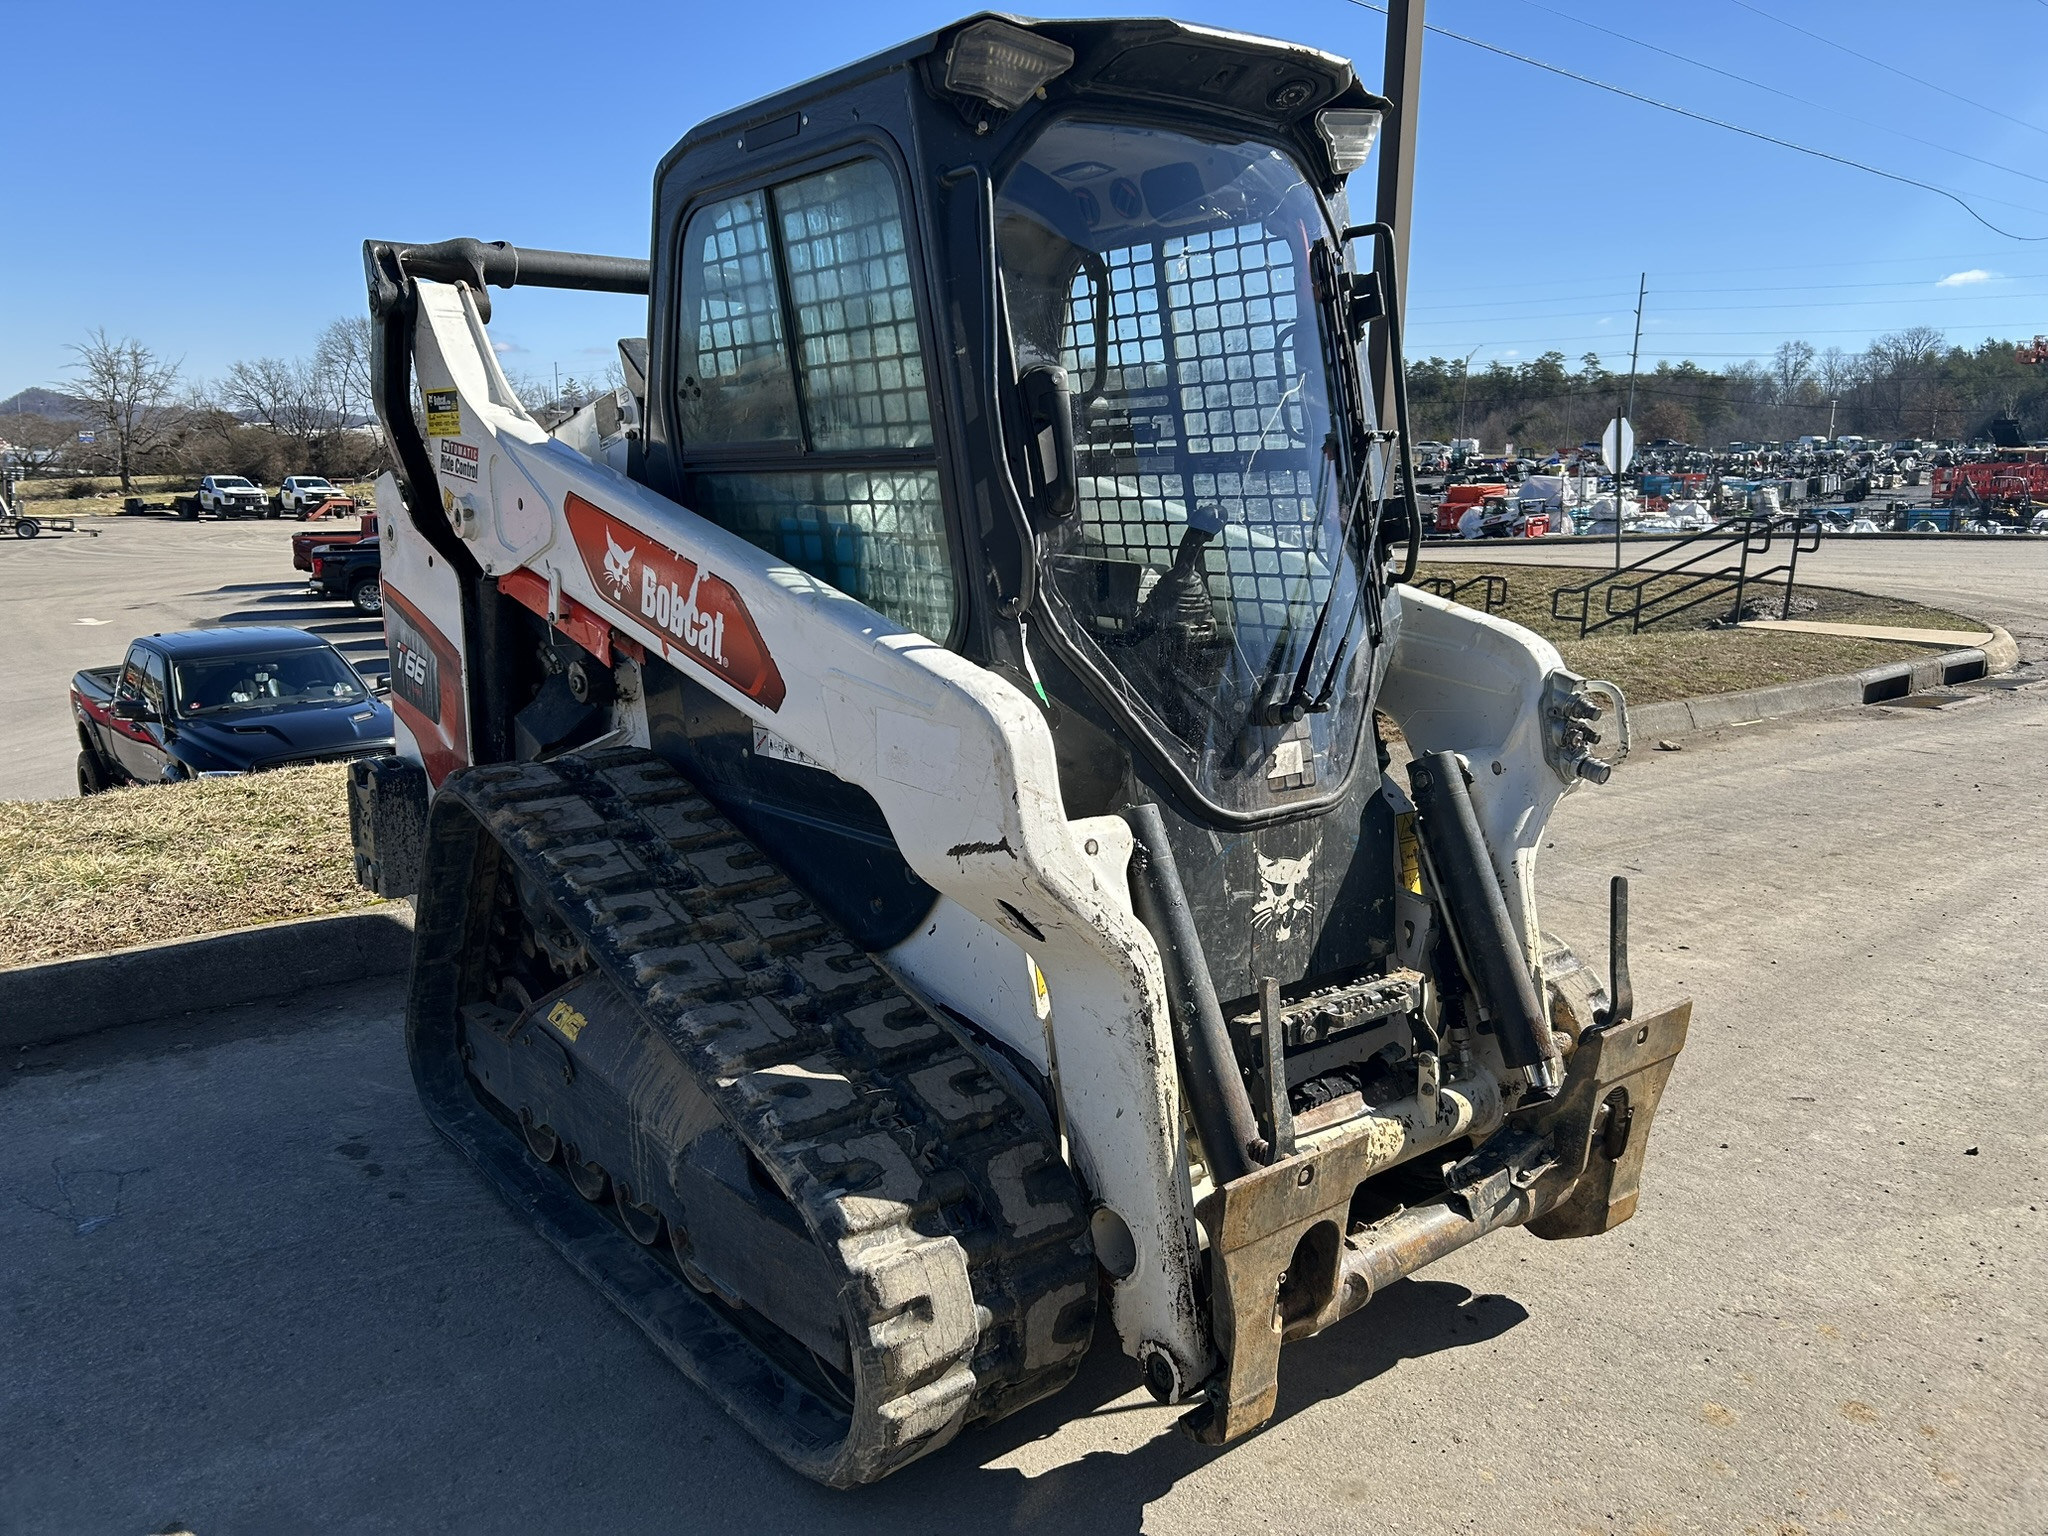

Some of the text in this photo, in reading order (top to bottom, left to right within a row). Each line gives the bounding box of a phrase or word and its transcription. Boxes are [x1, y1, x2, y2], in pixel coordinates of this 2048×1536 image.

[440, 454, 478, 479] Ride Control
[641, 564, 724, 664] Bobcat
[397, 641, 427, 686] T66
